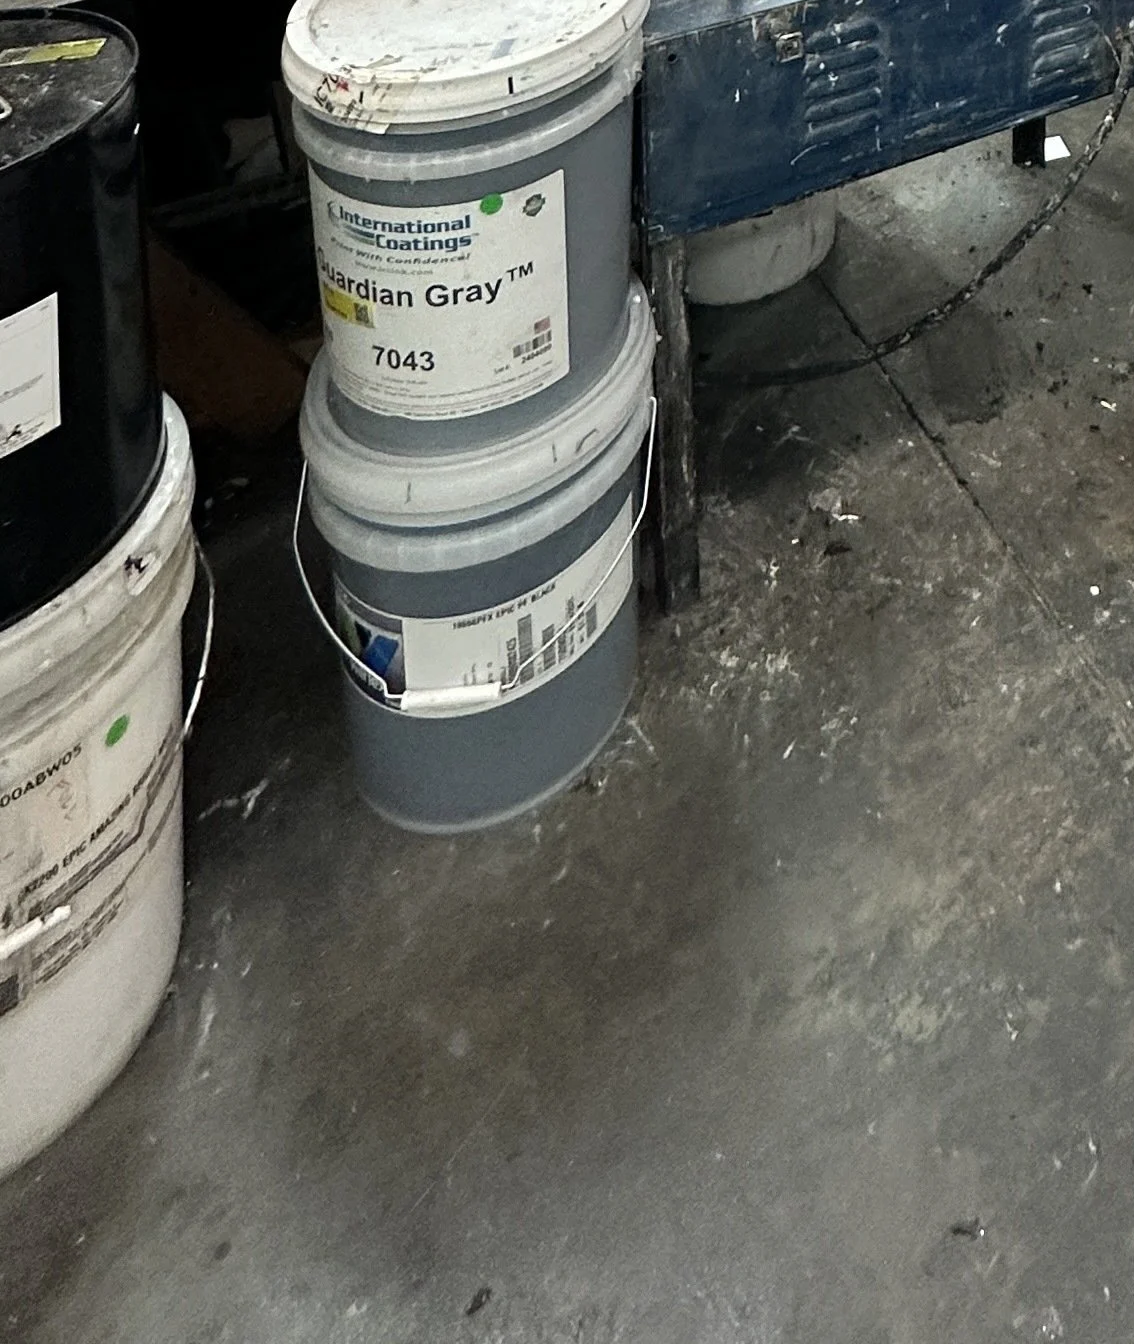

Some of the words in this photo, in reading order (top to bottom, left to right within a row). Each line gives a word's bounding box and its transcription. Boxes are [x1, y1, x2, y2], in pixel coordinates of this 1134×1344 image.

[339, 206, 471, 235] International
[374, 233, 472, 253] Coatings
[356, 249, 383, 263] With
[371, 344, 435, 372] 7043
